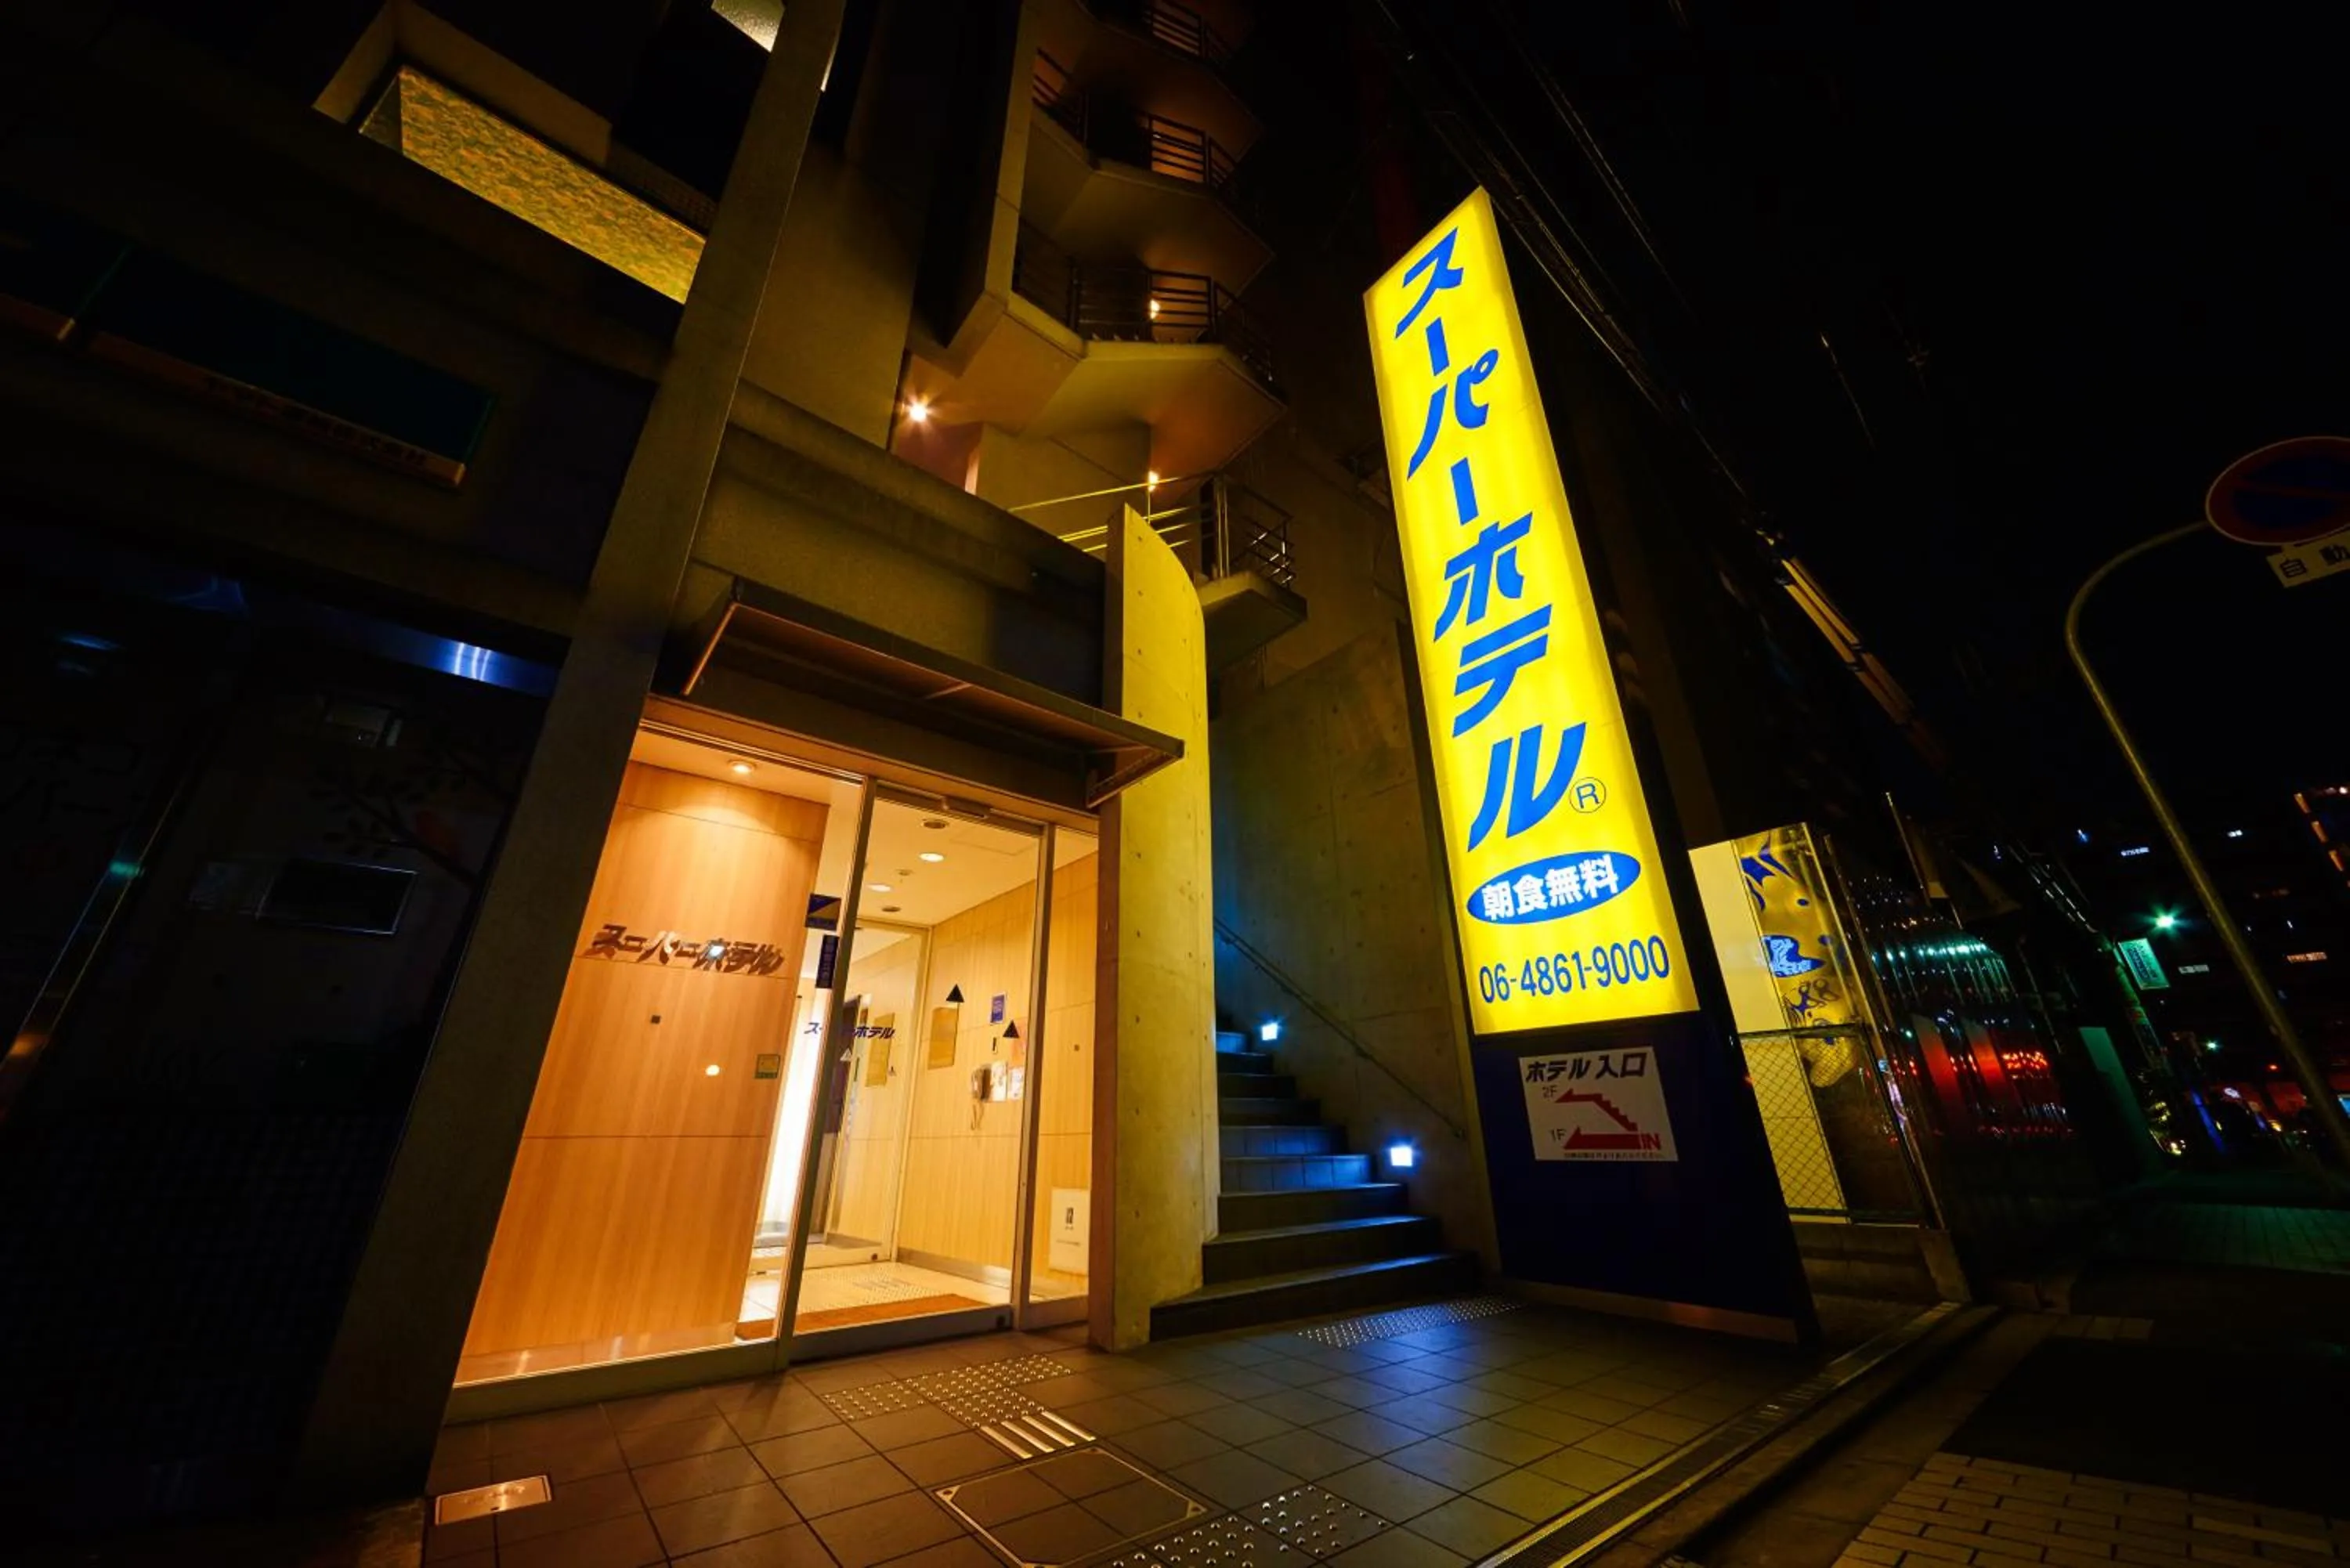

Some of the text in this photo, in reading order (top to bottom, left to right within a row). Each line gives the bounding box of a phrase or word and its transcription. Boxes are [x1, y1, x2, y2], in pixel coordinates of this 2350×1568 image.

[1395, 226, 1586, 852] スーパーホテル
[1482, 854, 1620, 921] 朝食無料
[1480, 934, 1670, 1003] 06-4861-9000
[1542, 1085, 1557, 1098] 2F
[1551, 1129, 1566, 1142] 1F
